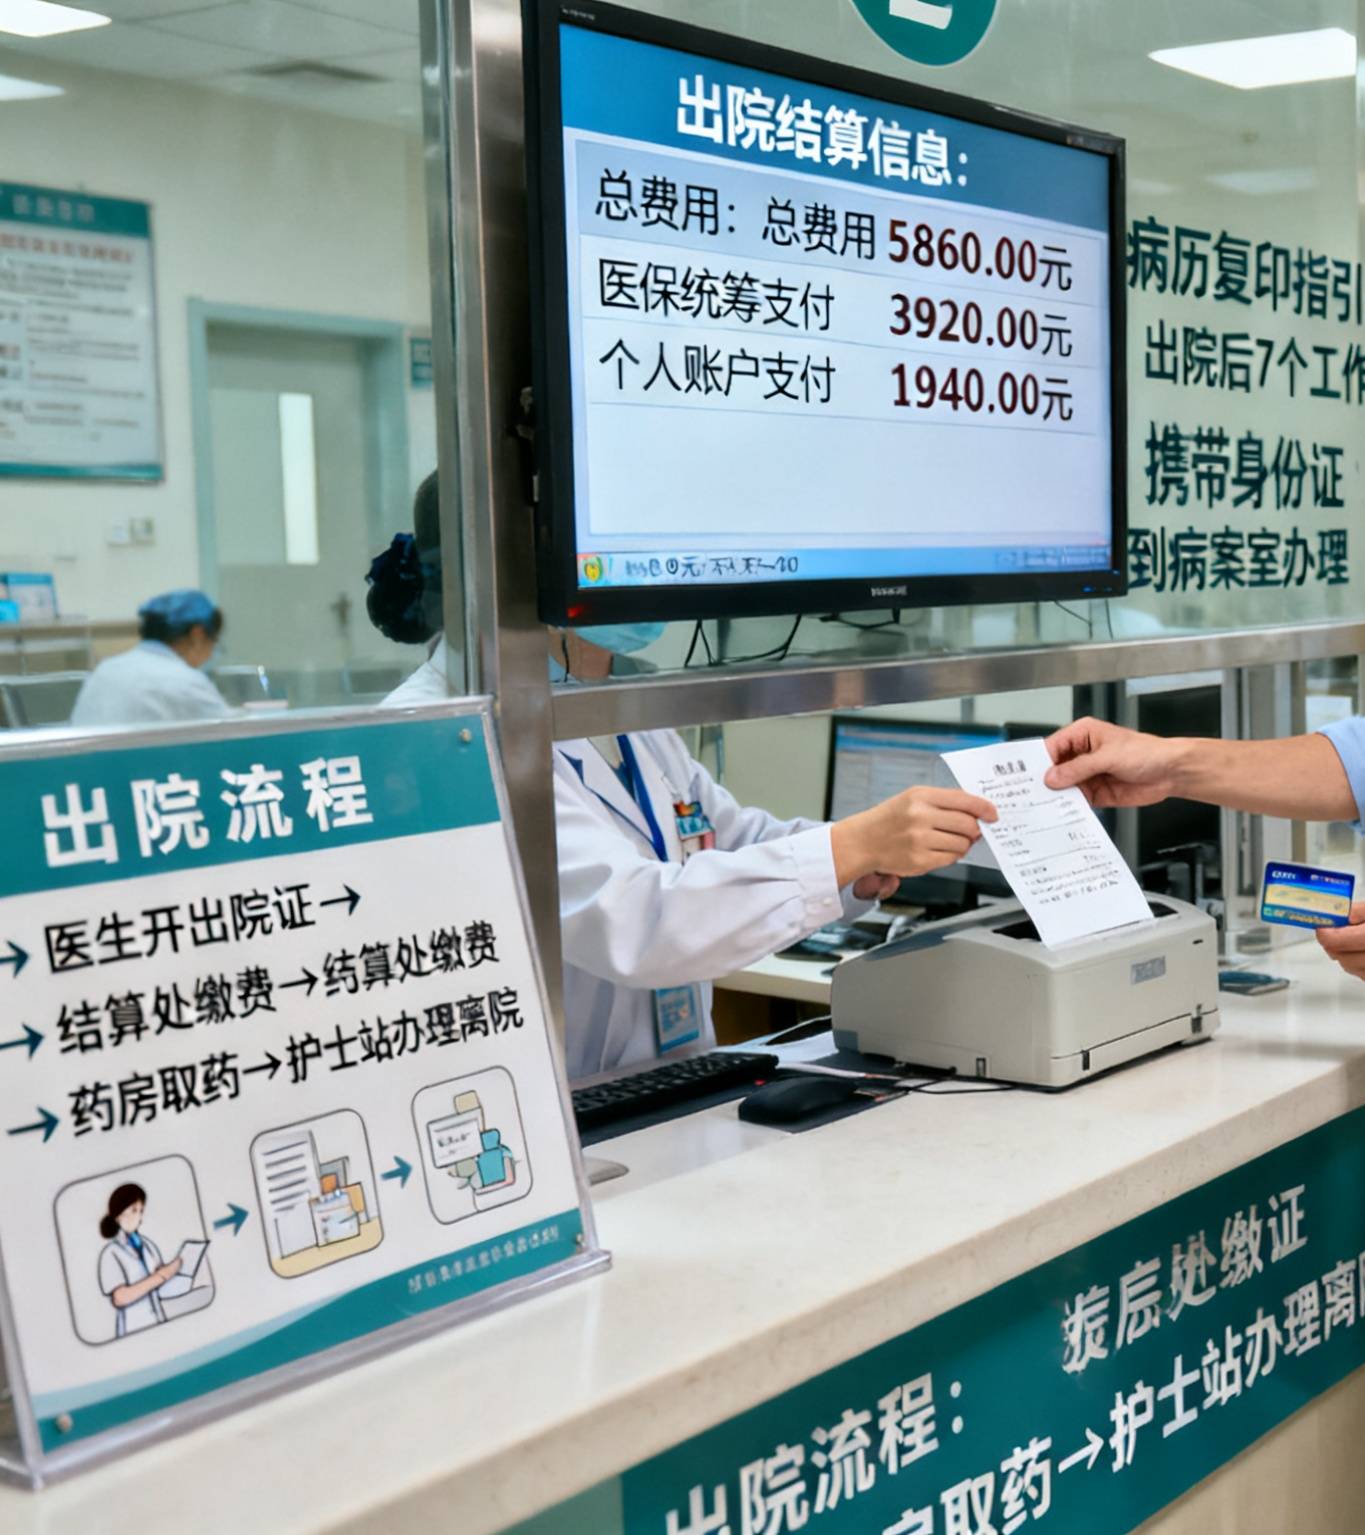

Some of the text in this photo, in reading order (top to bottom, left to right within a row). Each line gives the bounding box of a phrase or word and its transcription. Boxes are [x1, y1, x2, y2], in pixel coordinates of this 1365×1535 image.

[676, 75, 968, 187] 出院结算信息：
[887, 218, 1073, 291] 5860.00元
[598, 258, 1073, 357] 医保统筹支付 3920.00元
[598, 339, 1074, 421] 个人账户支付 1940.00元
[1145, 421, 1346, 510] 携带身份证
[1128, 525, 1349, 593] 到病案室办理
[41, 754, 376, 871] 出院流程
[43, 882, 318, 975] 医生开出院证
